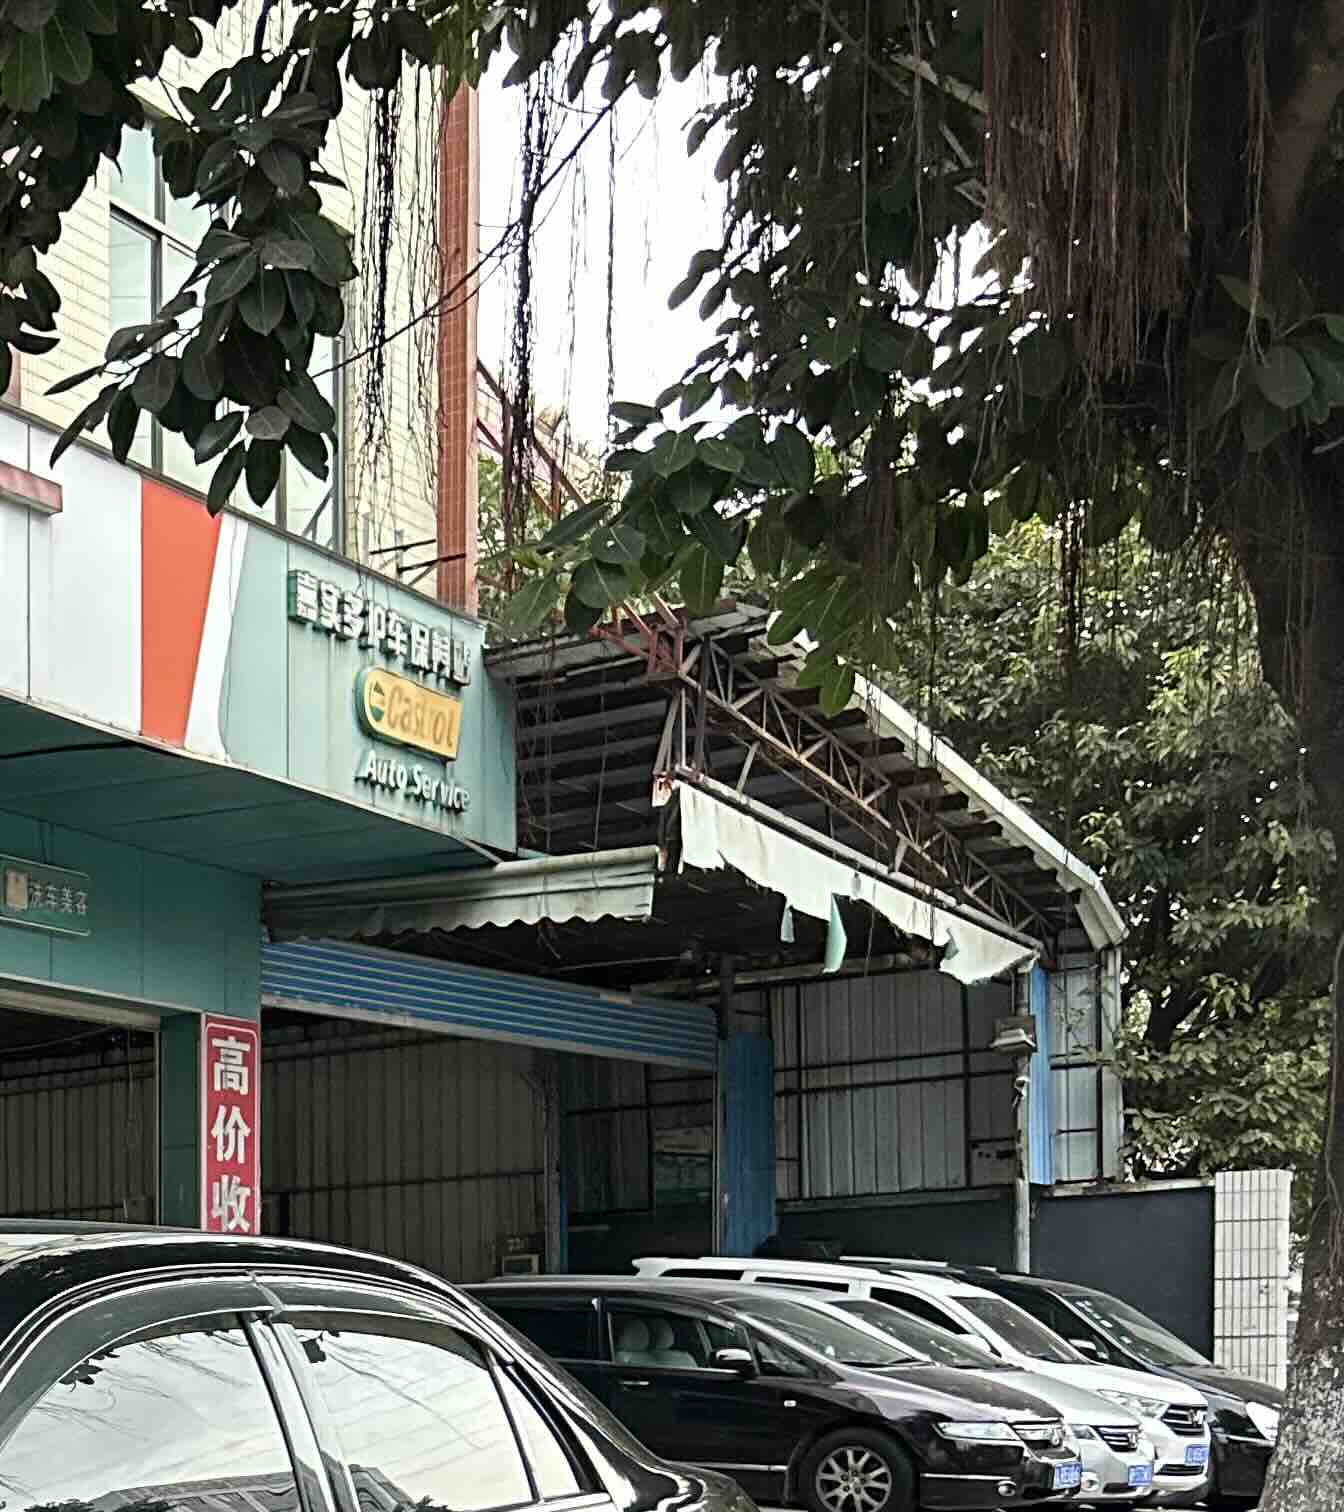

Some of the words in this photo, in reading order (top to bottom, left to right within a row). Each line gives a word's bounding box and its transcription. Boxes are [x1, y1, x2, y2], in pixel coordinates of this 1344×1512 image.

[365, 749, 408, 790] Auto
[412, 763, 471, 811] Service
[211, 1036, 251, 1233] 高价收
